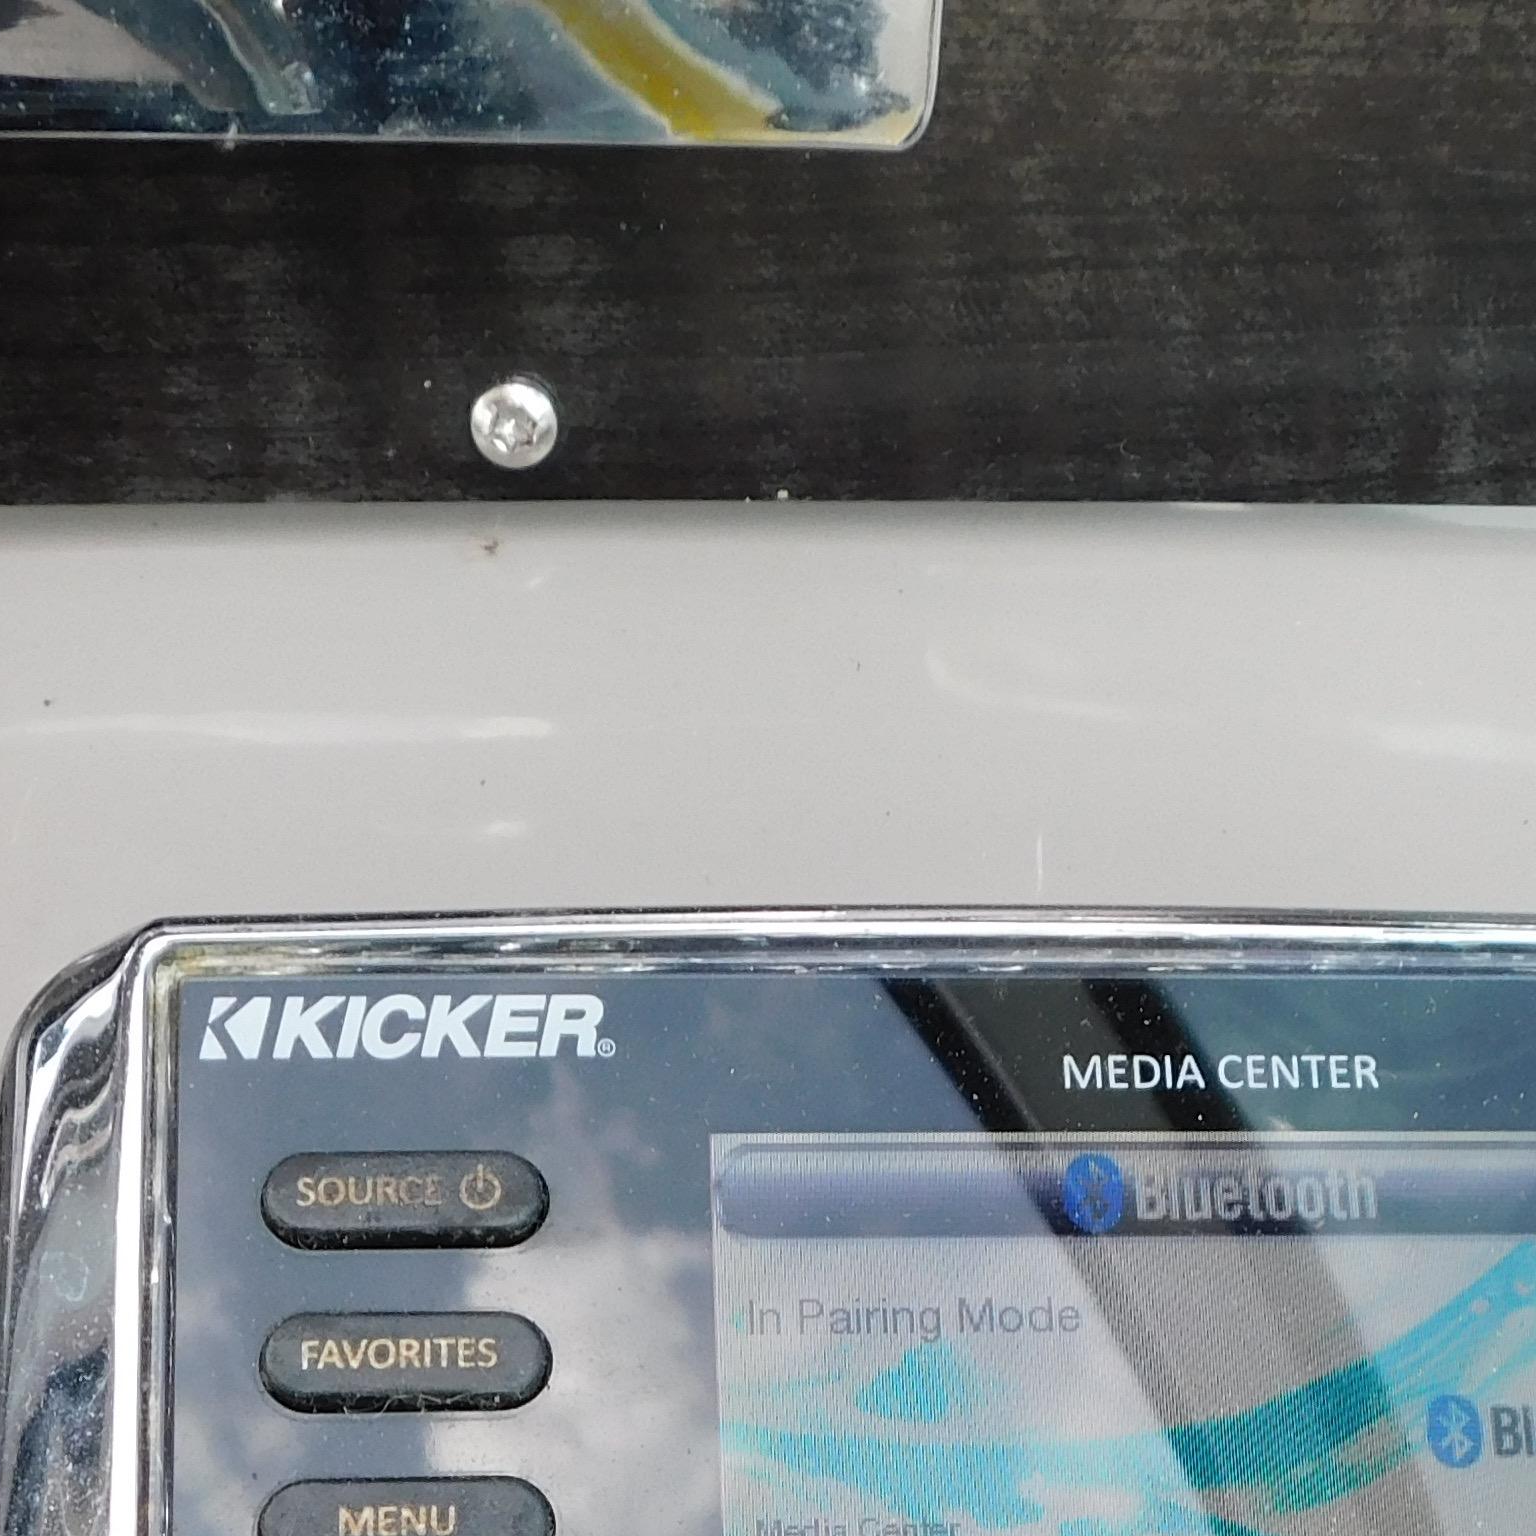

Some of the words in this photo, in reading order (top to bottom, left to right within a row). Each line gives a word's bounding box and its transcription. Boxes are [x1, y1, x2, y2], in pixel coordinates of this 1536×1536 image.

[1062, 1054, 1205, 1091] MEDIA
[1216, 1053, 1380, 1091] CENTER
[296, 1175, 443, 1208] SOURCE
[1131, 1163, 1380, 1226] Bluetooth
[745, 1299, 782, 1336] In
[797, 1296, 944, 1343] Pairing
[956, 1295, 1082, 1334] Mode
[300, 1336, 499, 1371] FAVORITES
[337, 1504, 457, 1536] MENU
